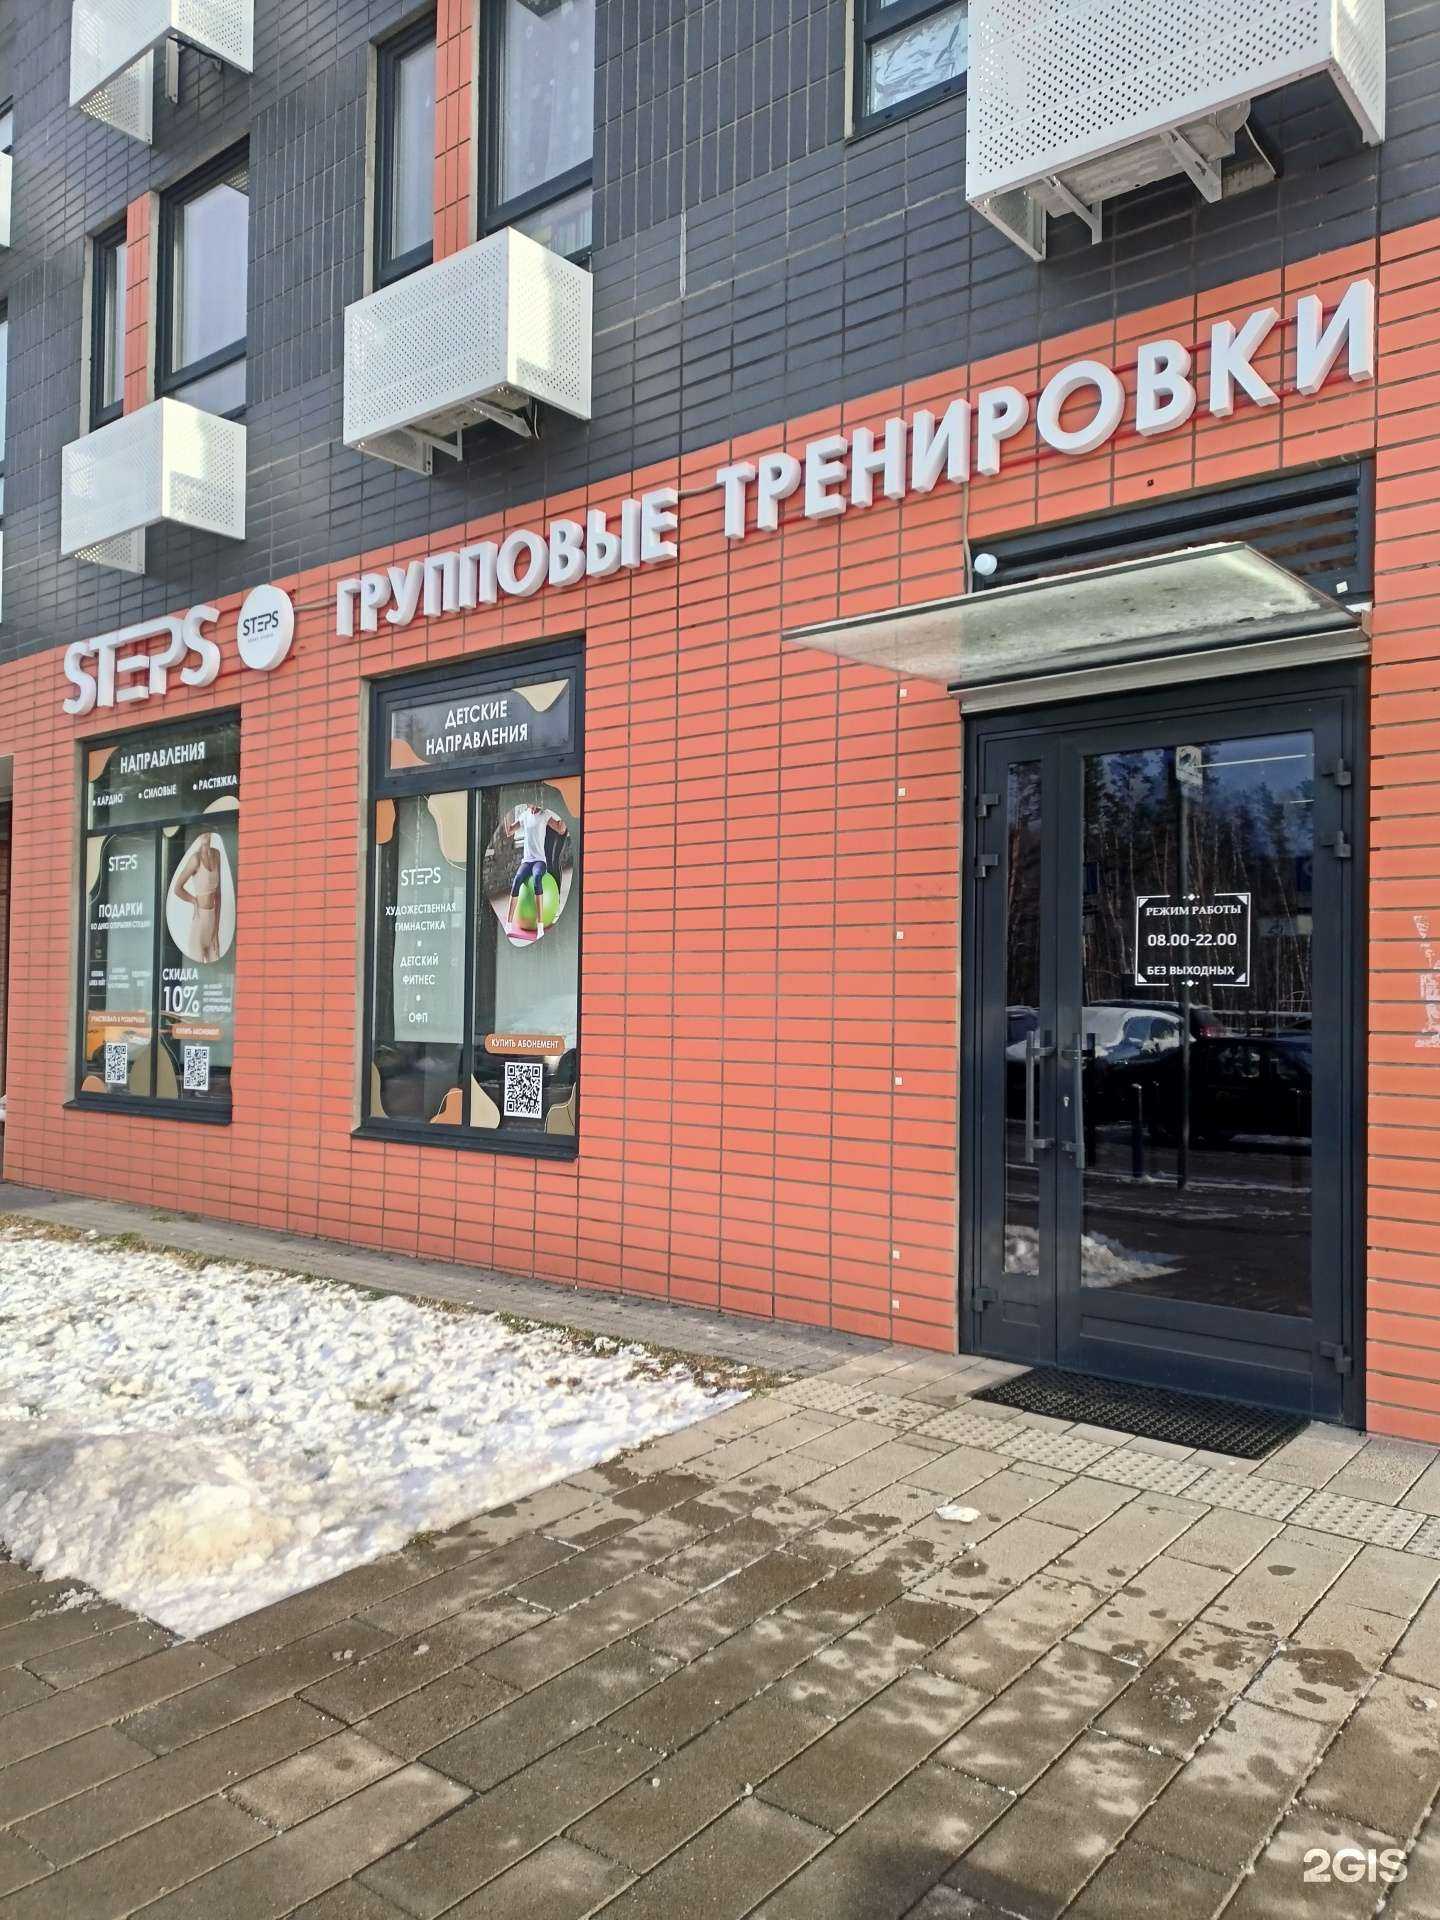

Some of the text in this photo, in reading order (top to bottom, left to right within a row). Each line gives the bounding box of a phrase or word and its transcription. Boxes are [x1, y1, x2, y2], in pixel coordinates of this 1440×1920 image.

[336, 278, 1375, 638] ГРУППОВЫЕ ТРЕНИРОВКИ
[242, 610, 279, 637] STEPS
[63, 604, 221, 715] STEPS
[444, 700, 508, 730] ДЕТСКИЕ
[425, 723, 528, 756] НАПРАВЛЕНИЯ
[119, 741, 206, 774] НАПРАВЛЕНИЯ
[97, 774, 238, 807] КАРДИО СИЛОВЫЕ РАСТЯЖКА
[108, 853, 138, 872] STEPS
[401, 866, 441, 886] STEPS
[98, 901, 143, 919] ПОДАРКИ
[385, 902, 457, 917] ХУДОЖЕСТВЕННАЯ
[1145, 904, 1242, 917] РЕЖИМ РАБОТЫ
[395, 920, 446, 932] ГИМНАСТИКА
[1147, 933, 1238, 947] 08.00-22.00
[400, 952, 439, 968] ДЕТСКИЙ
[162, 967, 199, 982] СКИДКА
[402, 974, 436, 986] ФИТНЕС
[1147, 966, 1235, 977] БЕЗ ВЫХОДНЫХ
[163, 985, 200, 1014] 10%
[408, 1012, 429, 1024] ОФП
[491, 1038, 559, 1049] КУПИТЬ АБОНЕМЕНТ
